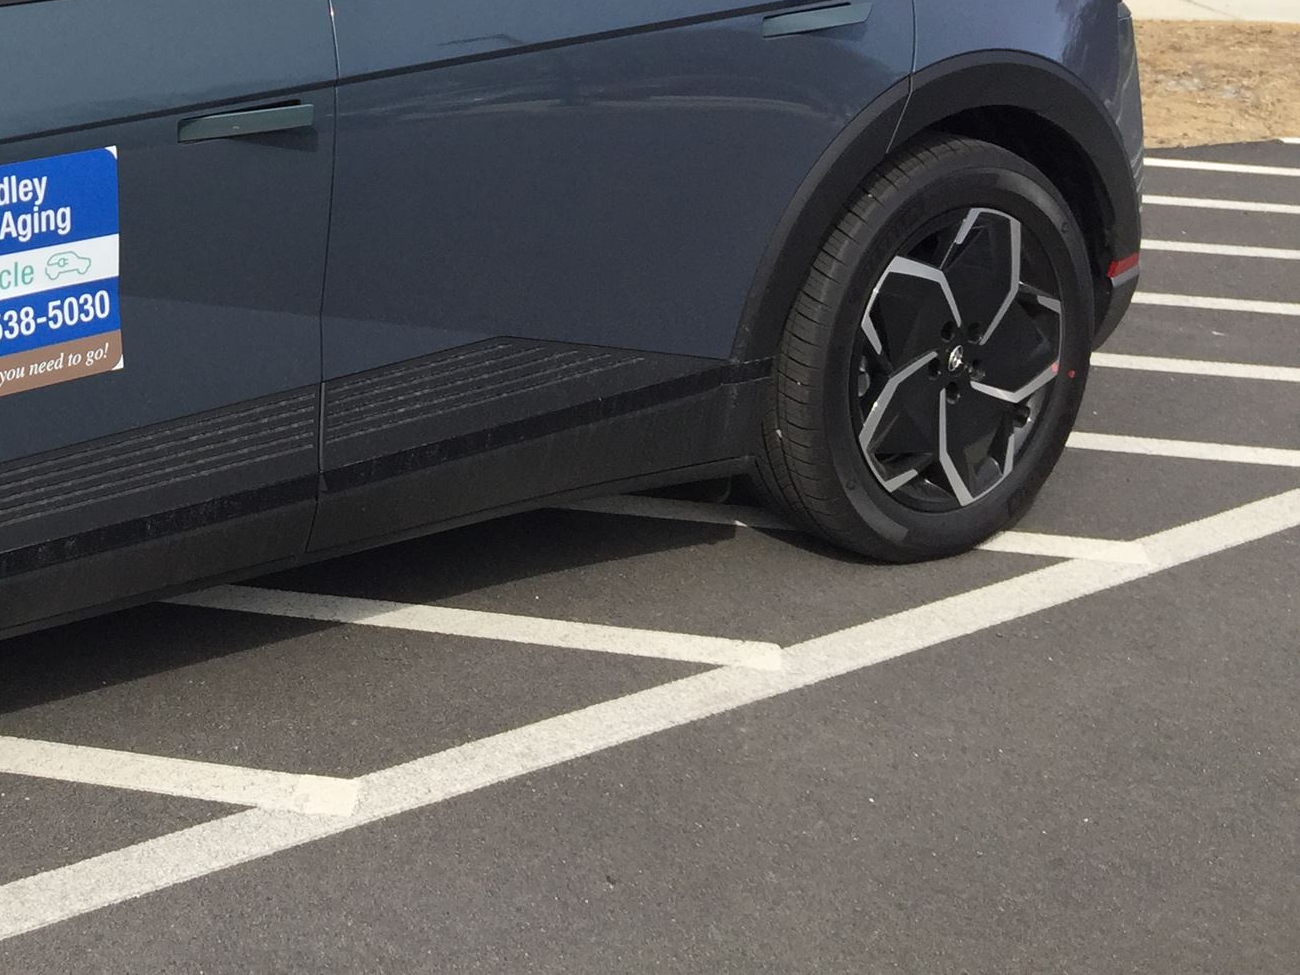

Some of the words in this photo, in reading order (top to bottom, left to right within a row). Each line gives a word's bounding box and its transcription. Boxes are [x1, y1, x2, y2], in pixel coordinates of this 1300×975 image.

[0, 206, 71, 242] Aging
[29, 353, 63, 376] need
[67, 351, 81, 366] to
[85, 342, 109, 366] go!
